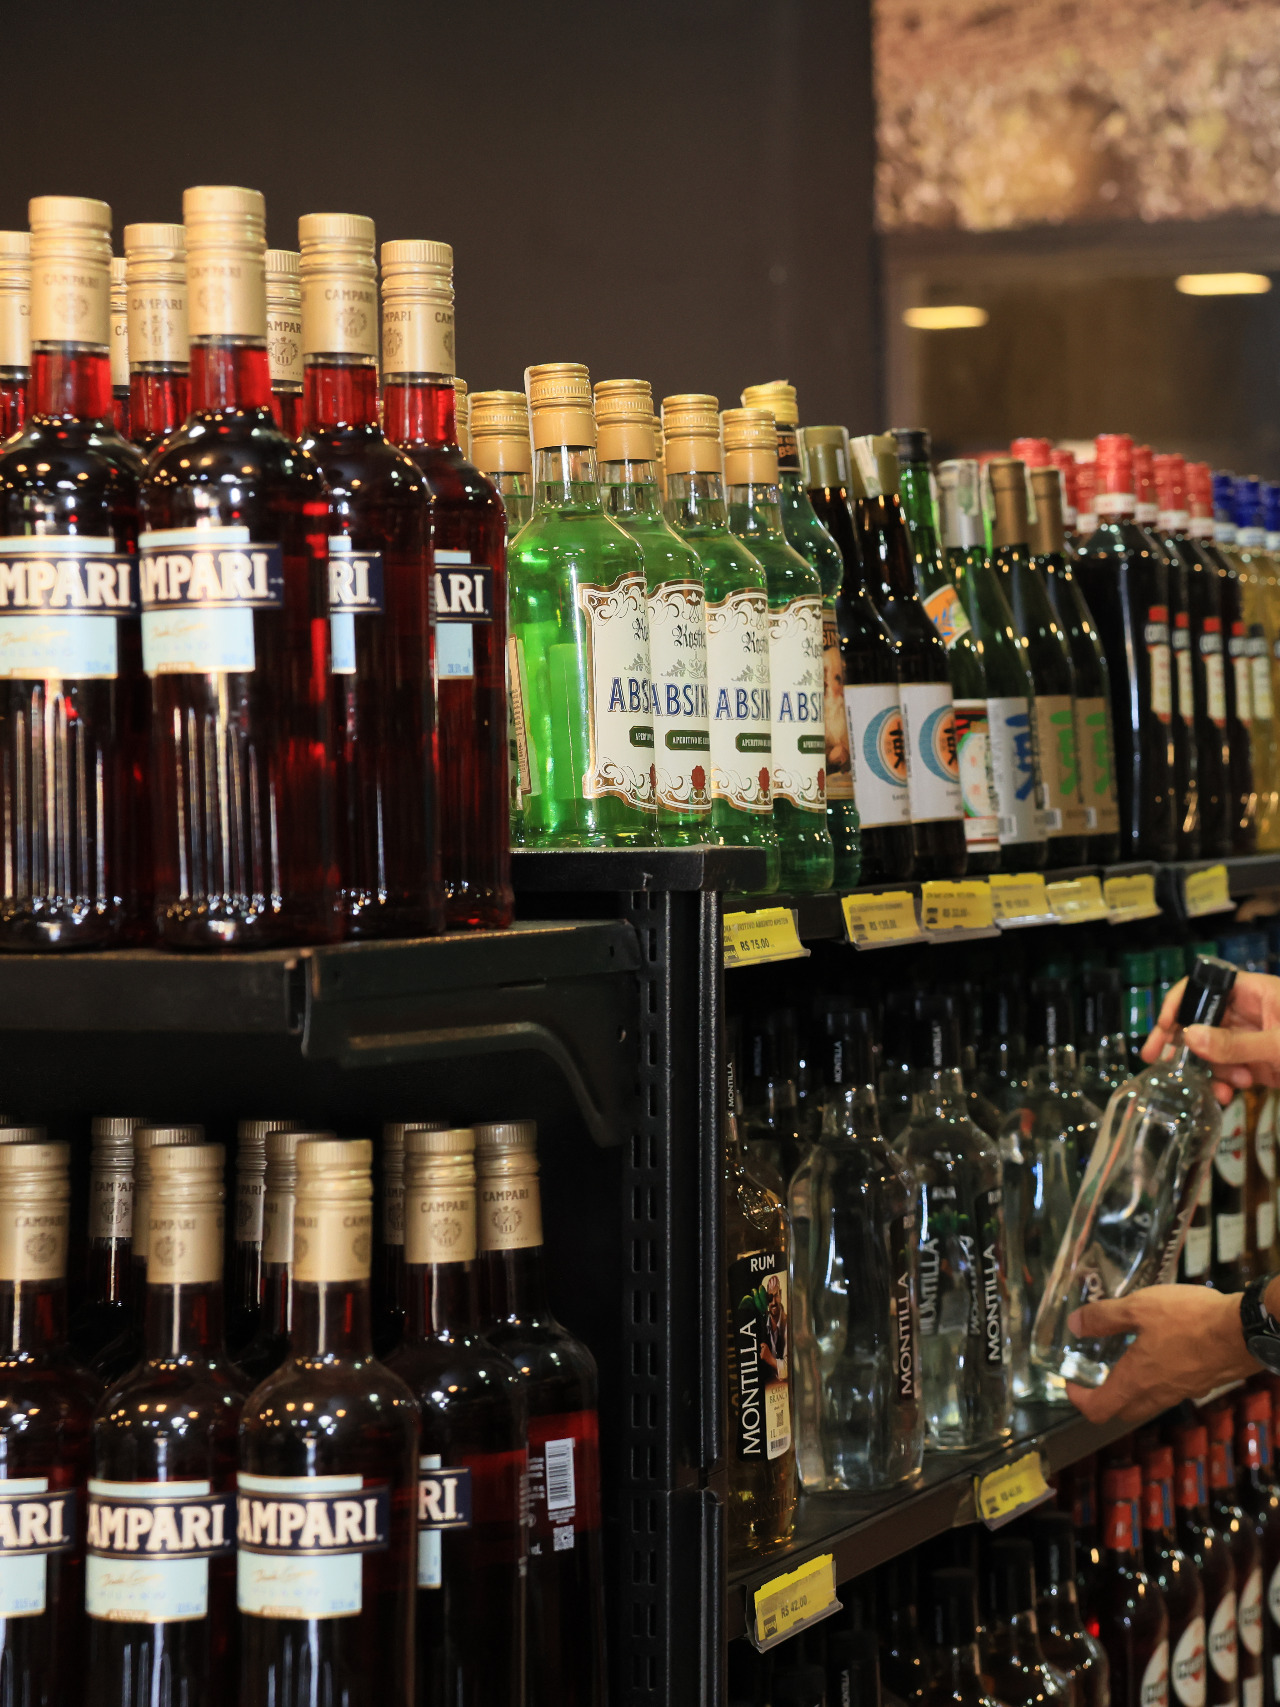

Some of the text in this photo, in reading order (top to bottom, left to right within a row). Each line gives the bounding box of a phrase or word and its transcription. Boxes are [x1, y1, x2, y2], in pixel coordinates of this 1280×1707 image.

[131, 298, 183, 311] CAMPARI
[267, 320, 301, 334] AMPAR
[726, 1062, 736, 1107] MONTILLA
[94, 1180, 133, 1193] CAMPAR
[482, 1188, 529, 1202] CAMPARI
[421, 1200, 468, 1213] CAMPARI
[750, 1254, 775, 1272] RUM
[983, 1243, 1000, 1361] MONTILLA
[898, 1271, 912, 1395] MONTILLA
[739, 1318, 761, 1455] MONTILLA
